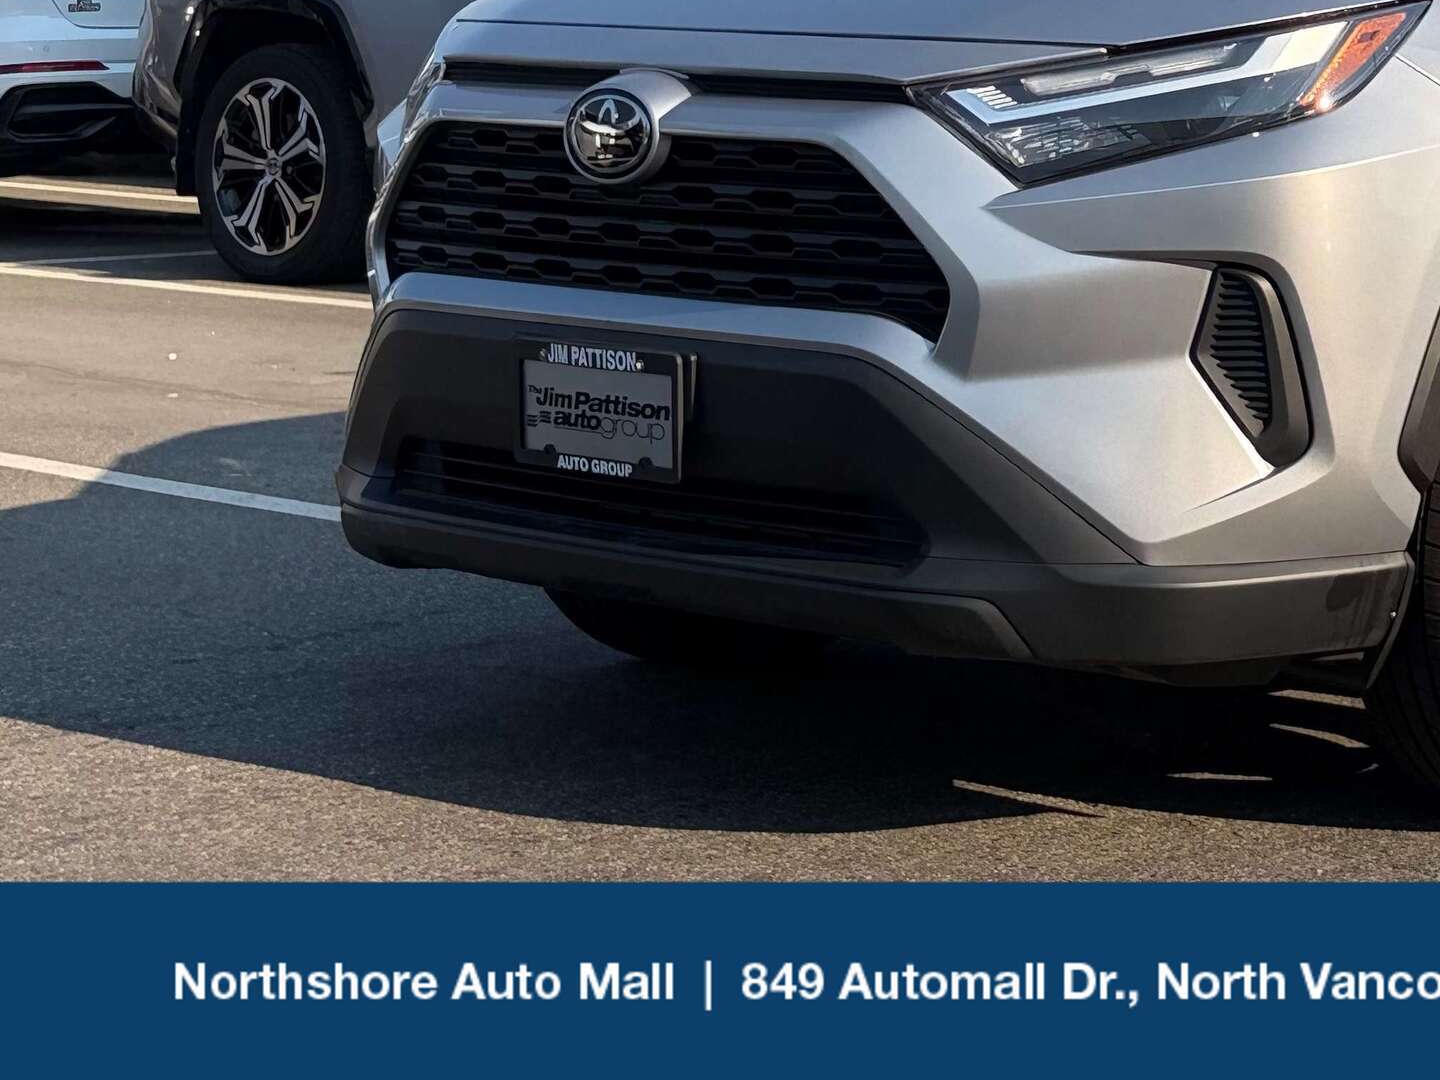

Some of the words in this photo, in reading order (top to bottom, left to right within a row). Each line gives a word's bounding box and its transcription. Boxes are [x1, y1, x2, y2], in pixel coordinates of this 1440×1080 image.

[547, 343, 569, 364] JIM
[570, 346, 636, 372] PATTISON
[536, 387, 572, 410] Jim
[574, 391, 670, 421] Pattison
[556, 454, 590, 472] AUTO
[590, 458, 633, 478] GROUP
